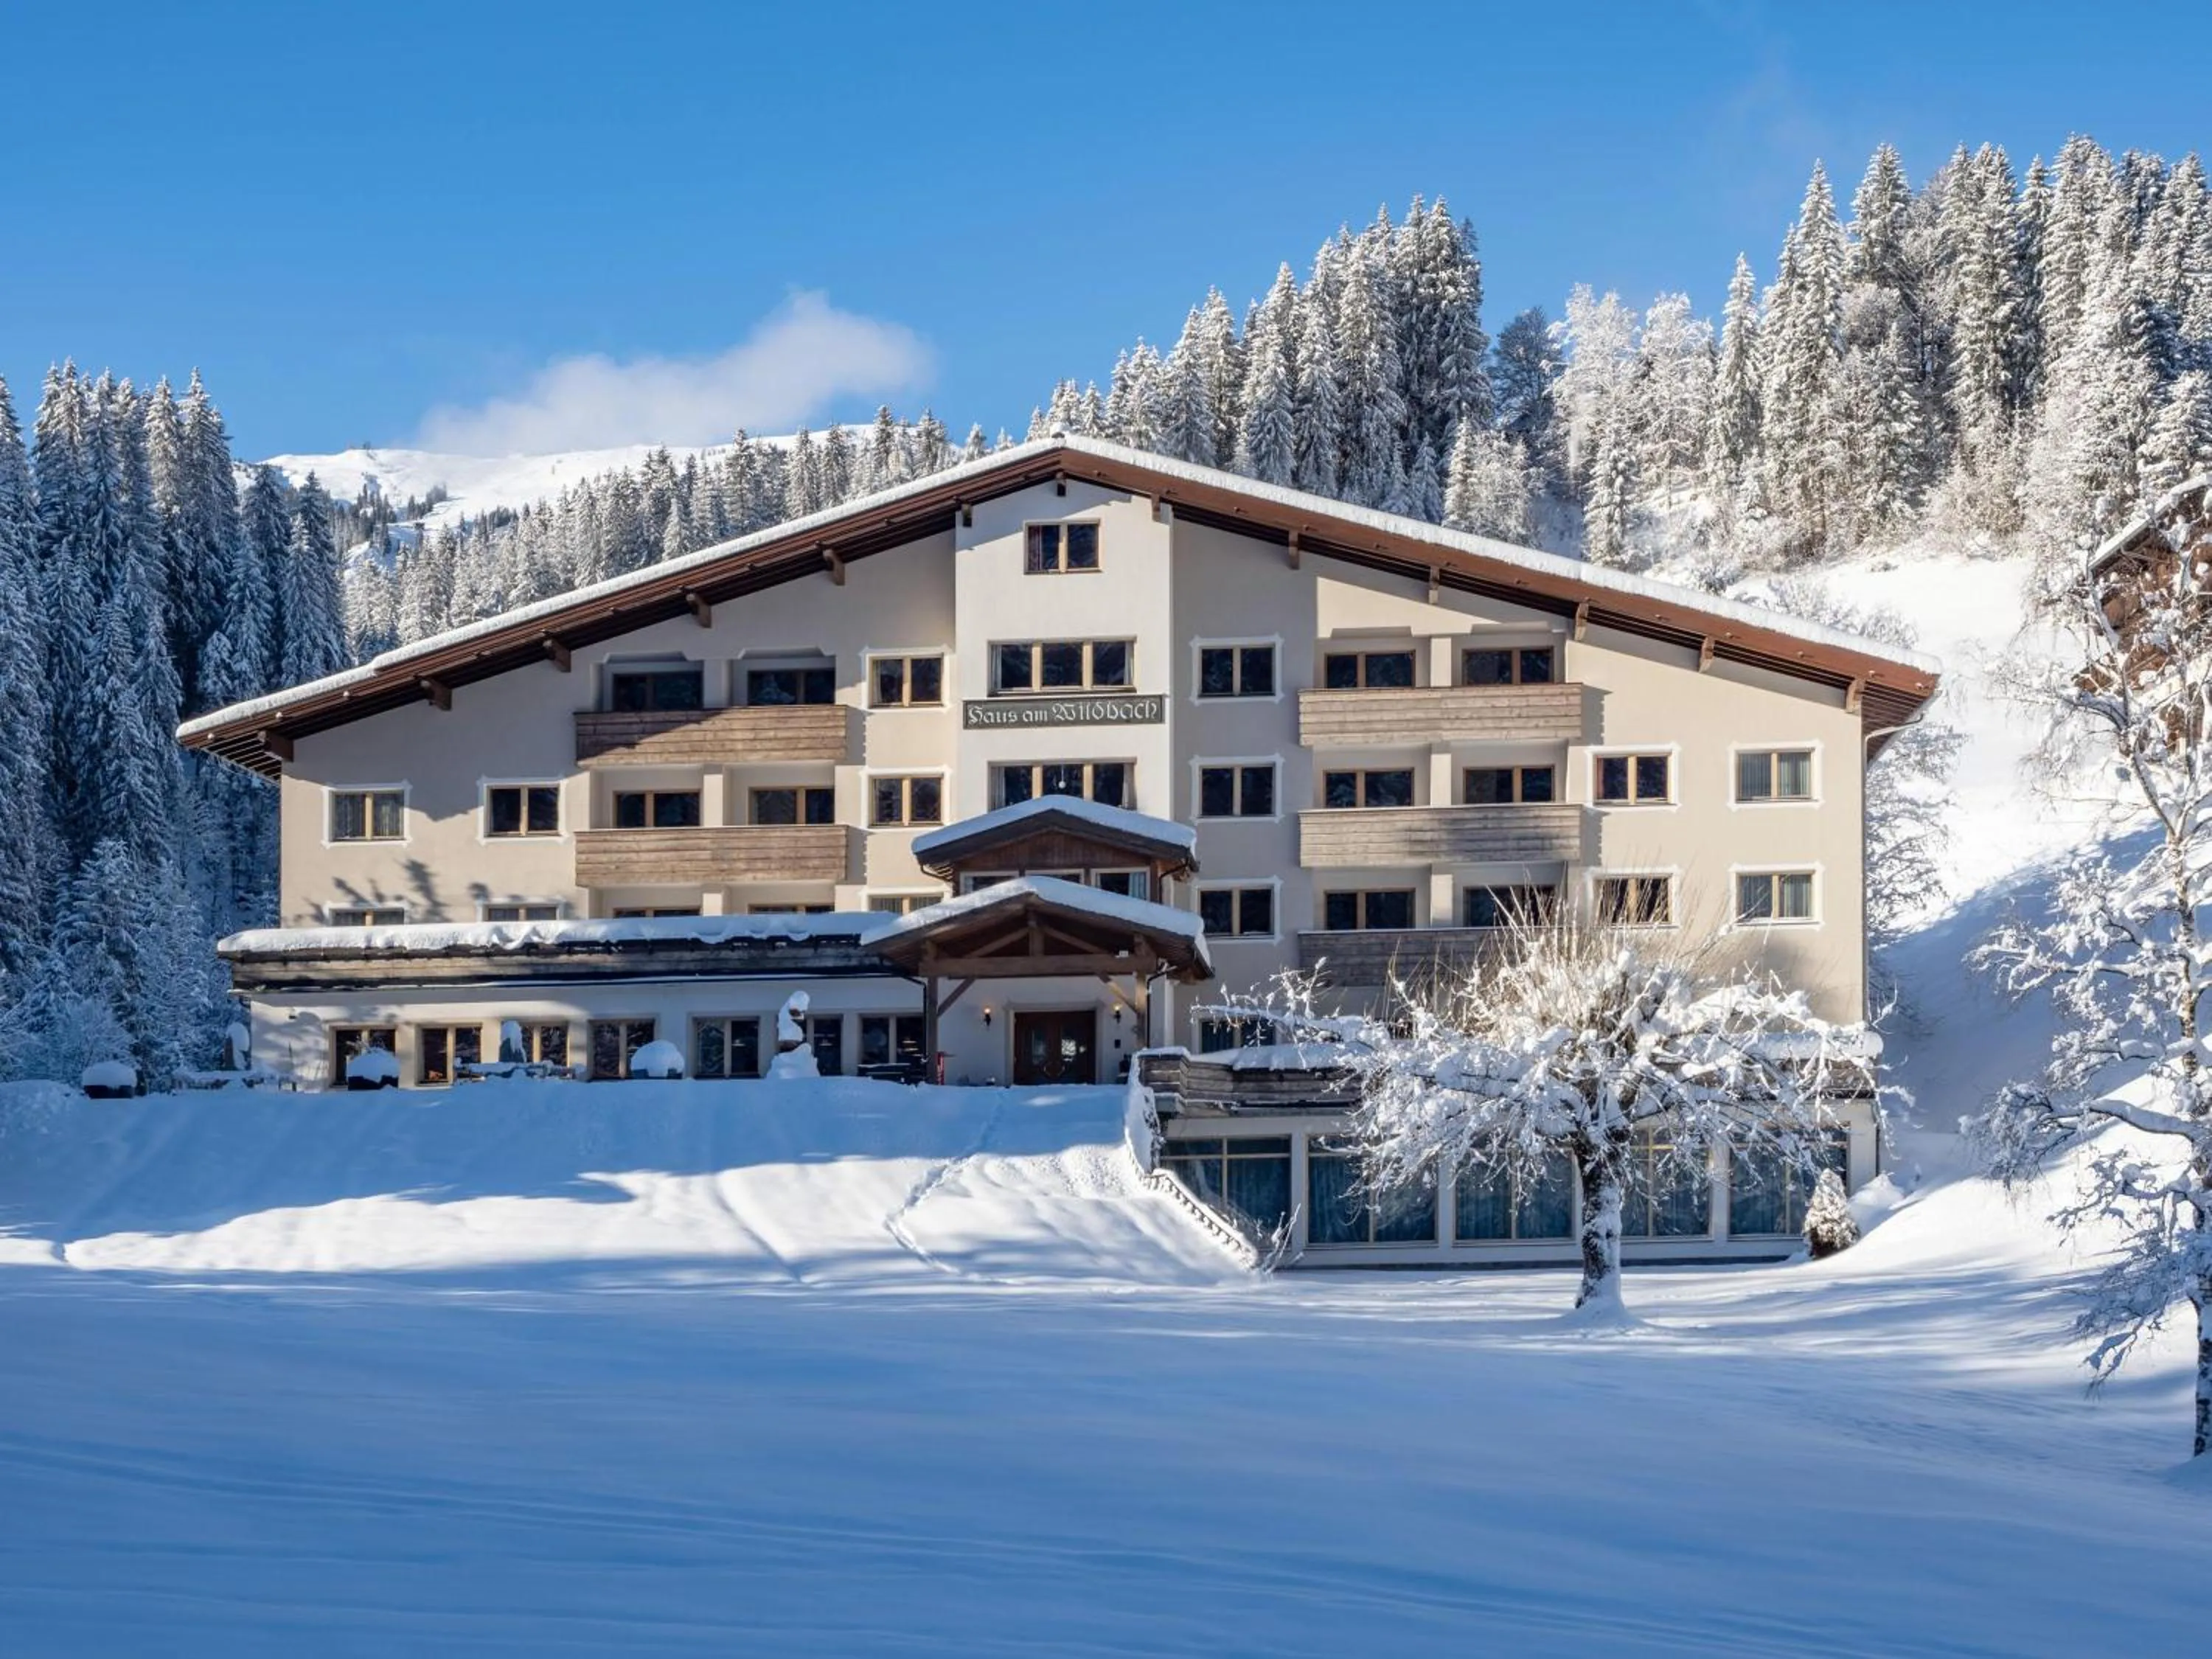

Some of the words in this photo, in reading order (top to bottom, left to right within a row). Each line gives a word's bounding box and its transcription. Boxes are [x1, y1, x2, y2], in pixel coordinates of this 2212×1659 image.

[967, 705, 1018, 724] Haus
[1023, 710, 1048, 722] am
[1052, 700, 1157, 720] Wildbach
